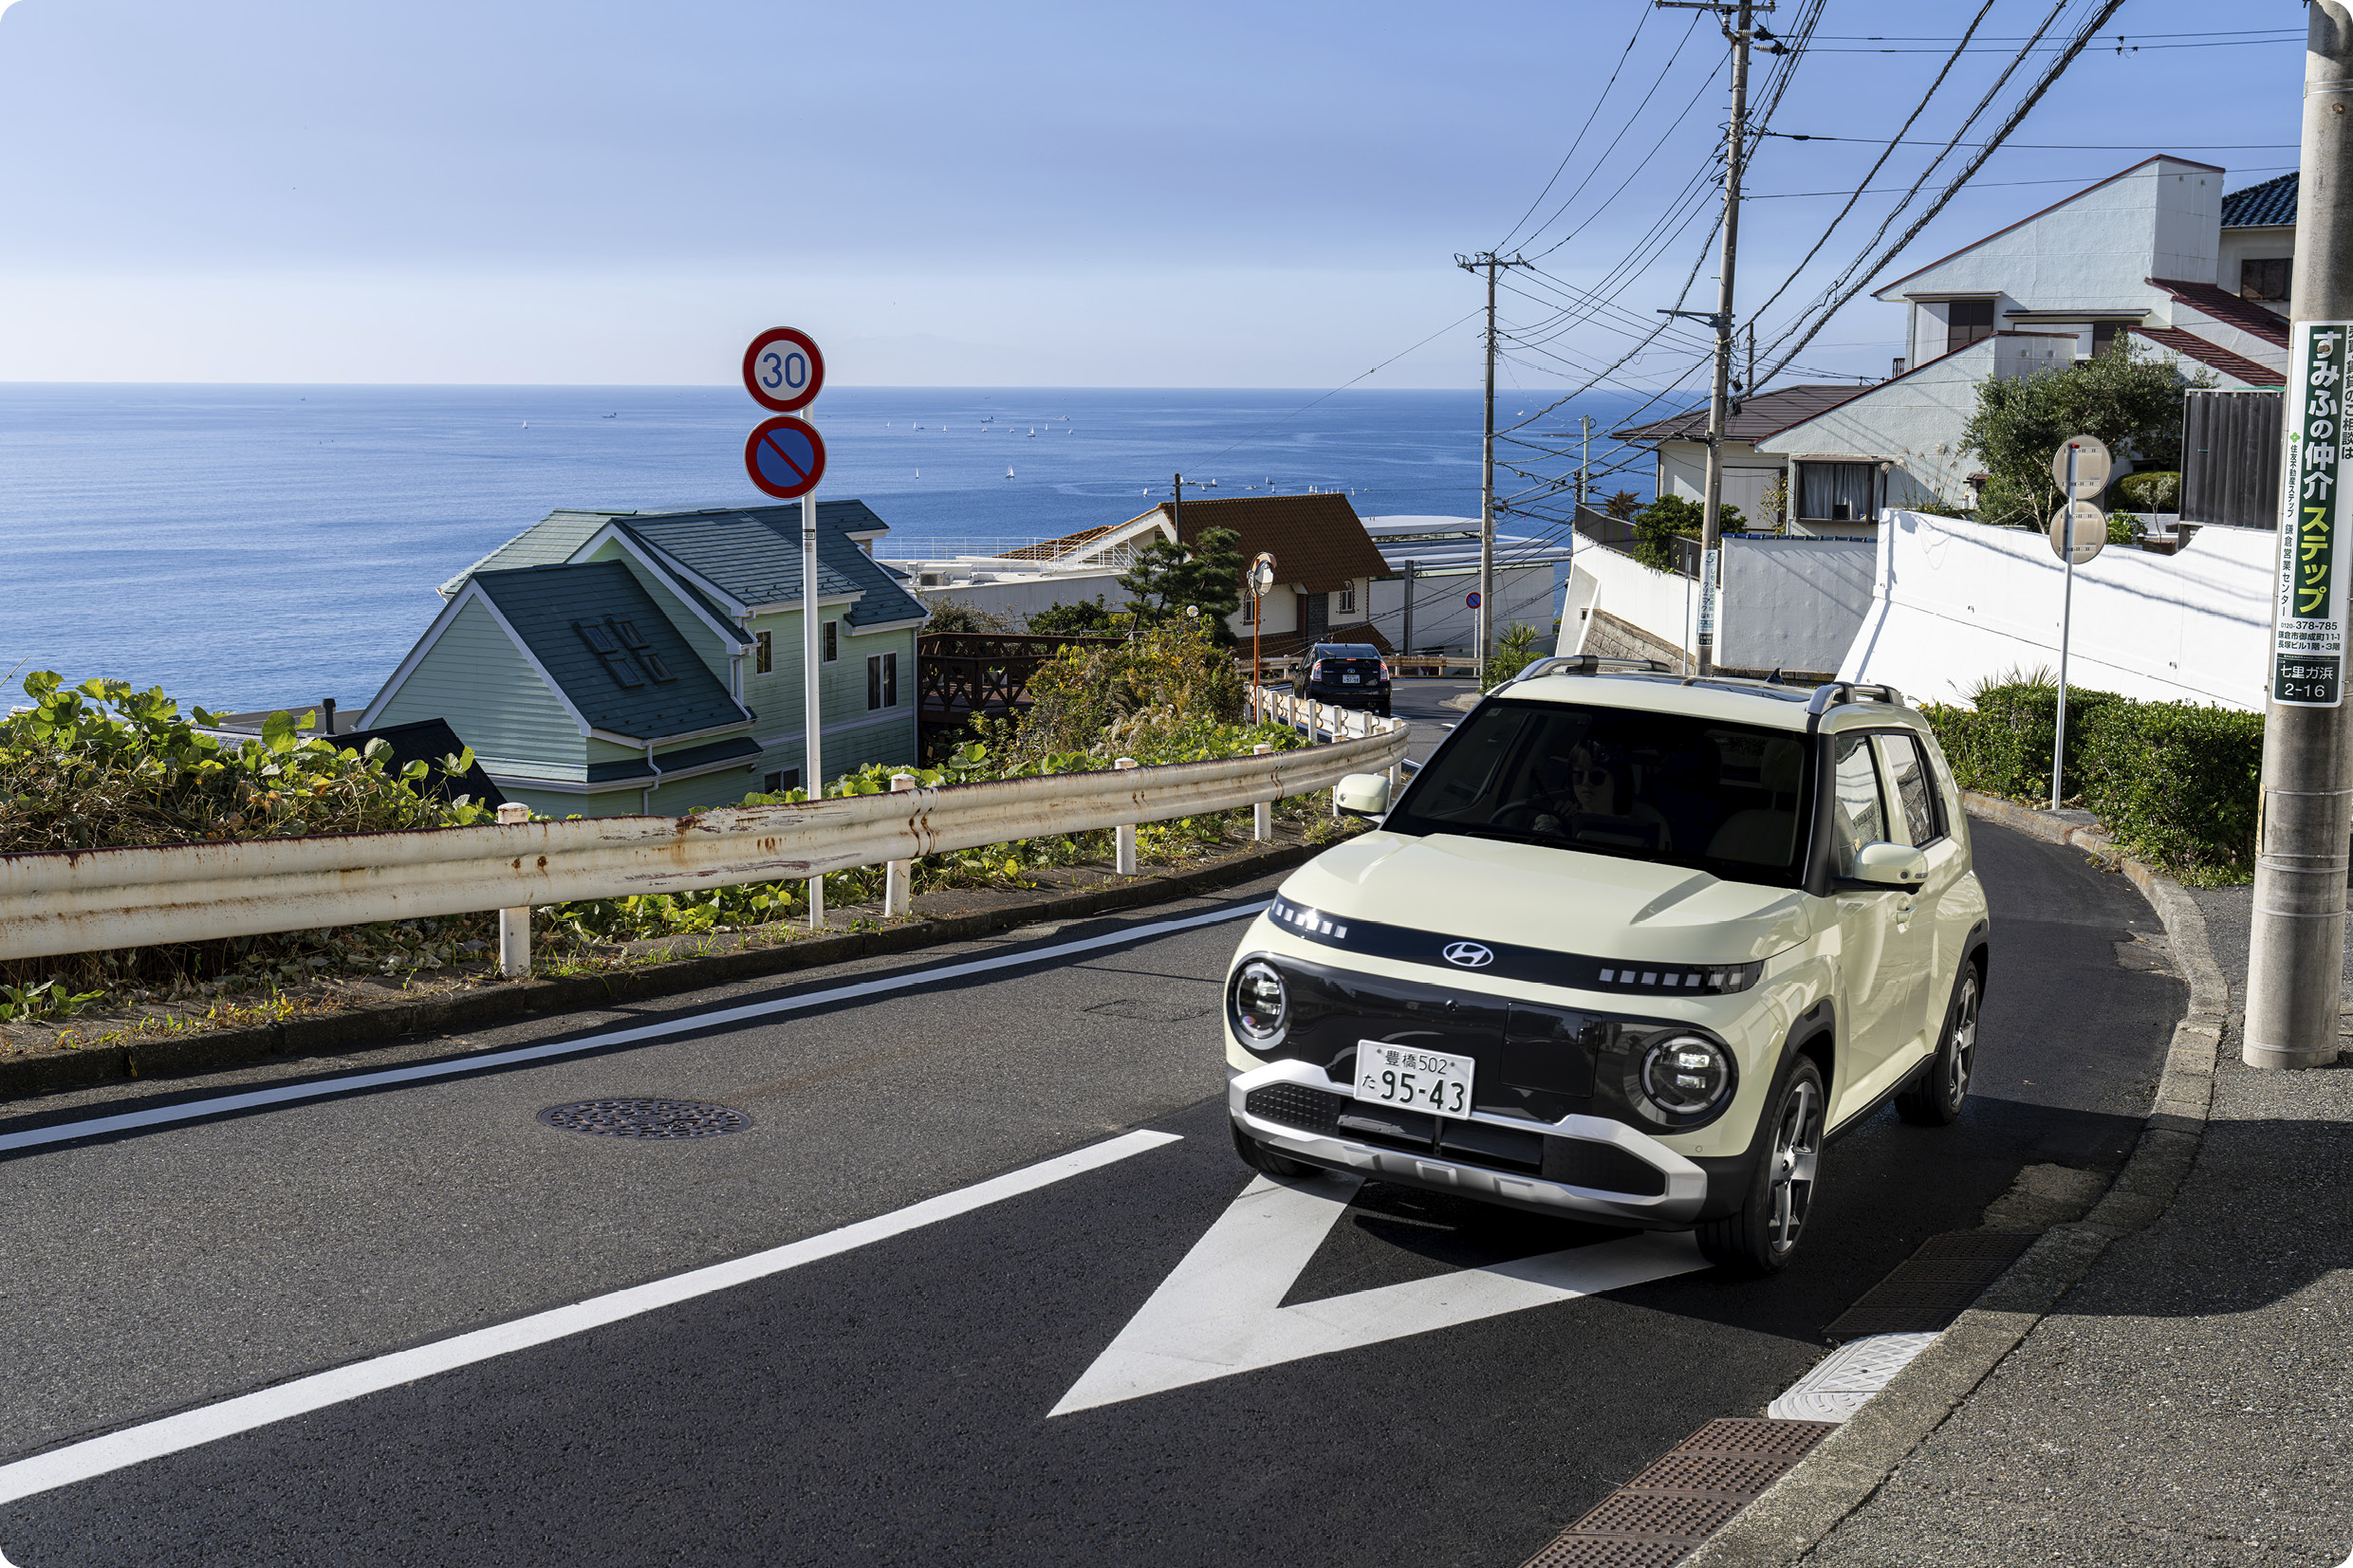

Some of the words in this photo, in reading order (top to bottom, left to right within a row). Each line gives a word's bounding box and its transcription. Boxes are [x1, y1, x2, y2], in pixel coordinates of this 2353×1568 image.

[762, 352, 806, 389] 30
[2287, 444, 2298, 518] 住友不動産ステップ
[2298, 330, 2343, 613] すみふの仲介ステップ
[2285, 683, 2325, 697] 2-16
[1362, 1073, 1376, 1089] た
[1380, 1070, 1465, 1113] 95-43
